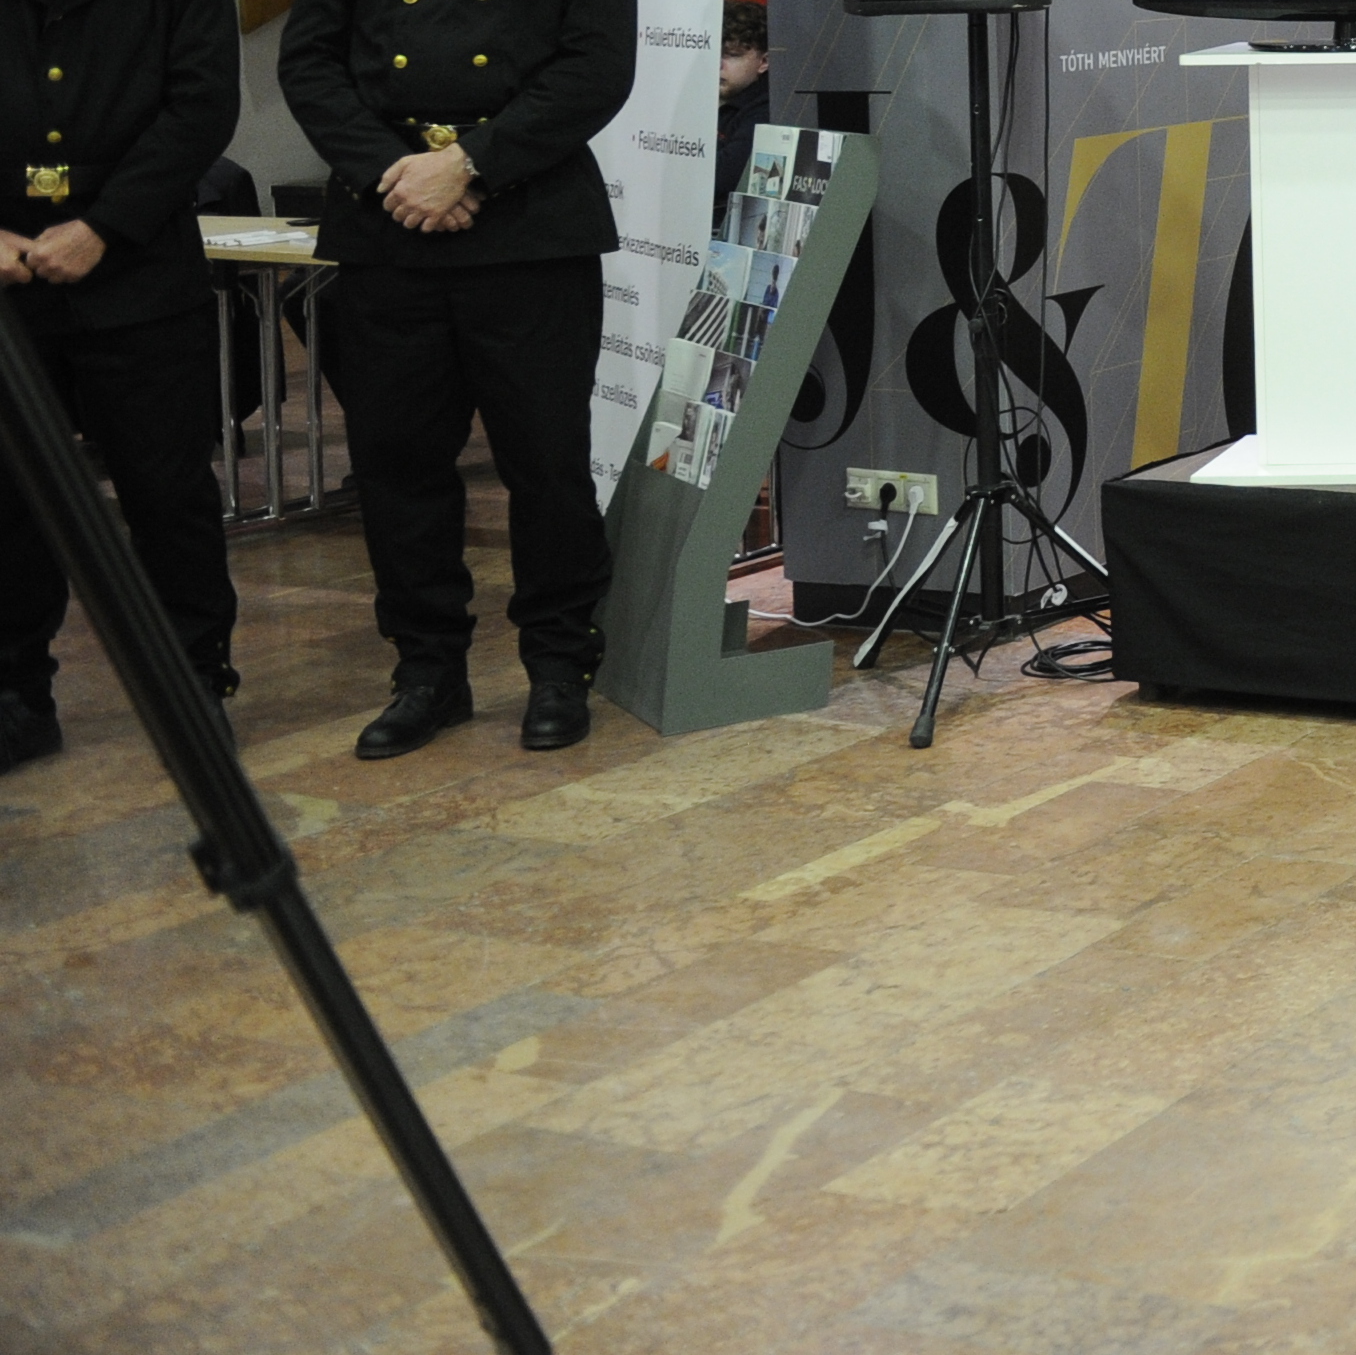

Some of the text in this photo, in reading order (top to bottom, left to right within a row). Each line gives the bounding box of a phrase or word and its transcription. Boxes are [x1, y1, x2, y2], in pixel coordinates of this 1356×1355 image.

[645, 26, 711, 50] Felületfűtések
[1060, 43, 1166, 72] TÓTH MENYHÉRT
